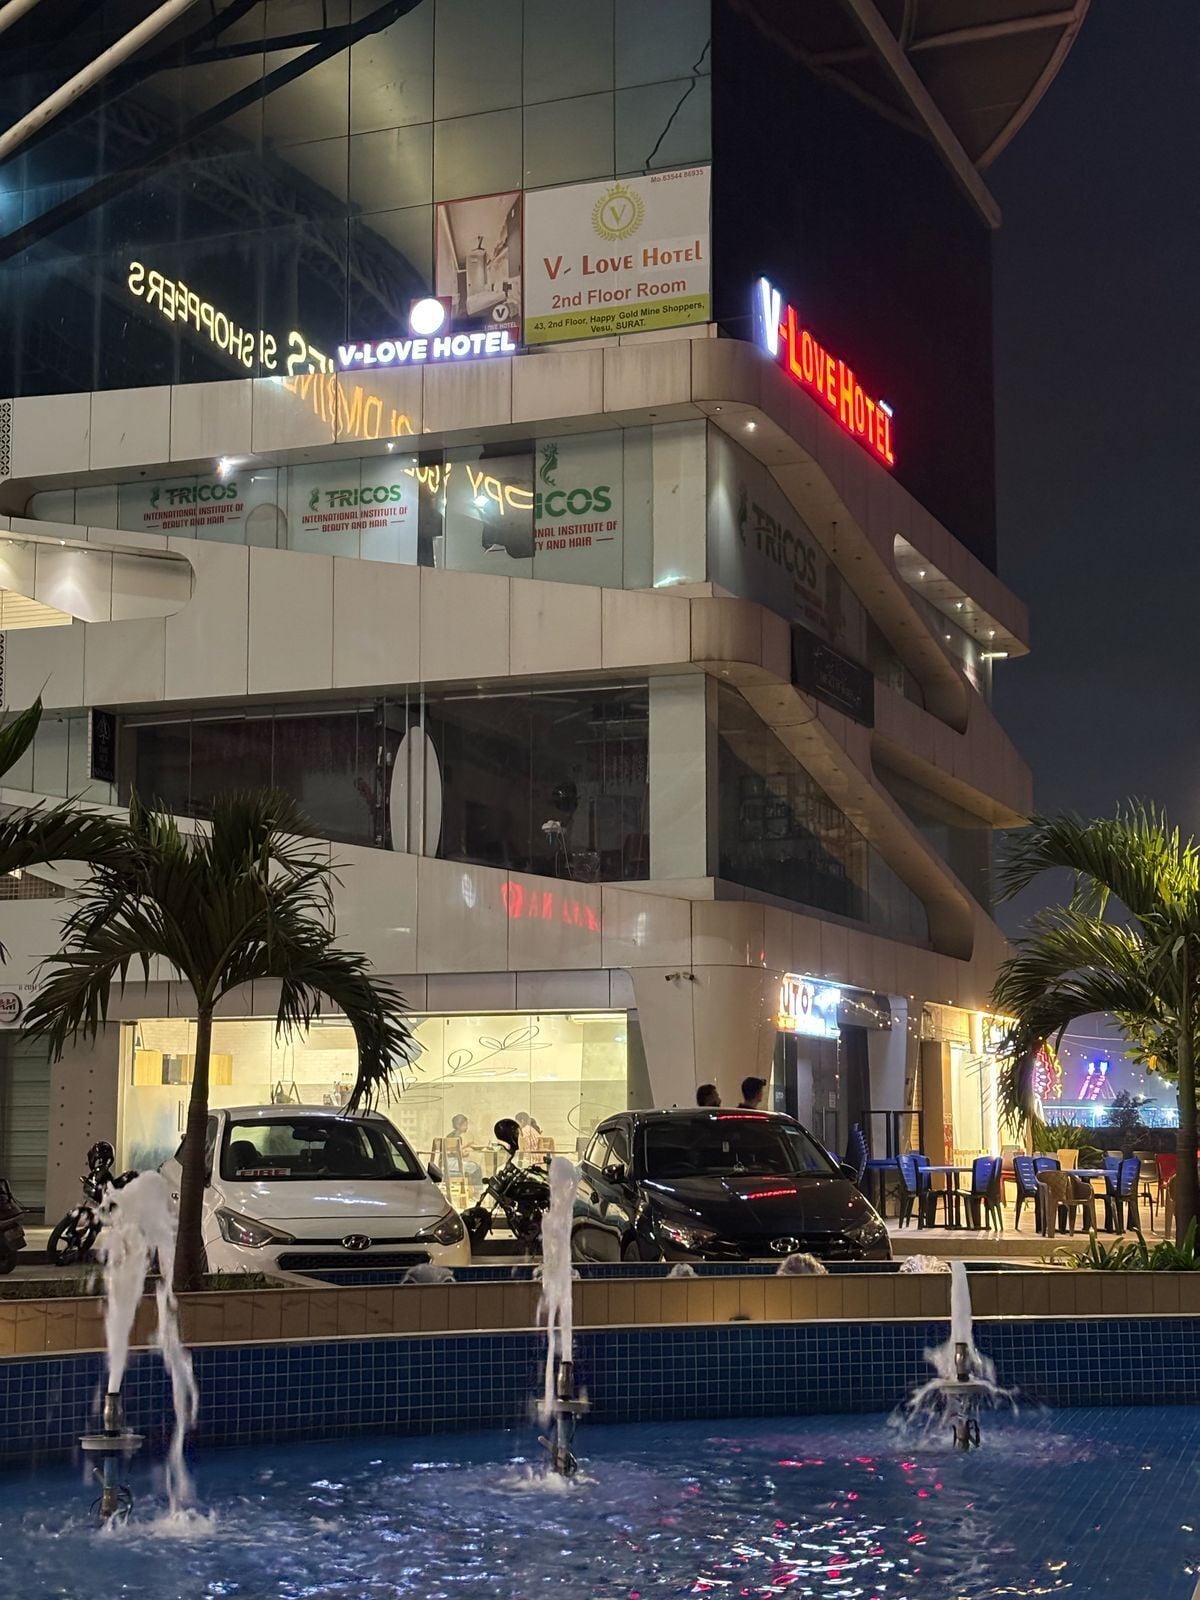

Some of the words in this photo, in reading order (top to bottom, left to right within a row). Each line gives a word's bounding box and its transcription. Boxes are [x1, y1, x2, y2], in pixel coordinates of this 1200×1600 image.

[609, 204, 626, 225] V
[552, 293, 582, 310] 2nd
[588, 288, 632, 305] Floor
[637, 280, 686, 298] Room
[534, 322, 546, 331] 43,
[548, 319, 563, 329] 2nd
[565, 316, 588, 327] Floor,
[590, 313, 616, 325] Happy
[619, 310, 638, 320] Gold
[640, 307, 660, 317] Mine
[662, 301, 705, 315] Shoppers,
[591, 324, 613, 334] Vesu,
[338, 338, 428, 366] V-LOVE
[433, 331, 516, 357] HOTEL
[165, 482, 238, 505] TRICOS
[325, 484, 402, 508] TRICOS
[143, 508, 197, 521] INTERNATIONAL
[199, 504, 233, 516] INSTITUTE
[234, 503, 244, 512] OF
[302, 511, 359, 524] INTERNATIONAL
[360, 508, 398, 519] INSTITUTE
[399, 506, 408, 515] OF
[162, 519, 189, 529] BEAUTY
[190, 517, 205, 527] AND
[206, 515, 225, 524] HAIR
[322, 522, 350, 533] BEAUTY
[351, 520, 367, 530] AND
[368, 519, 388, 528] HAIR
[558, 522, 604, 536] INSTITUTE
[606, 520, 618, 531] OF
[546, 538, 566, 550] AND
[568, 536, 592, 548] HAIR
[752, 502, 817, 589] TRICOS
